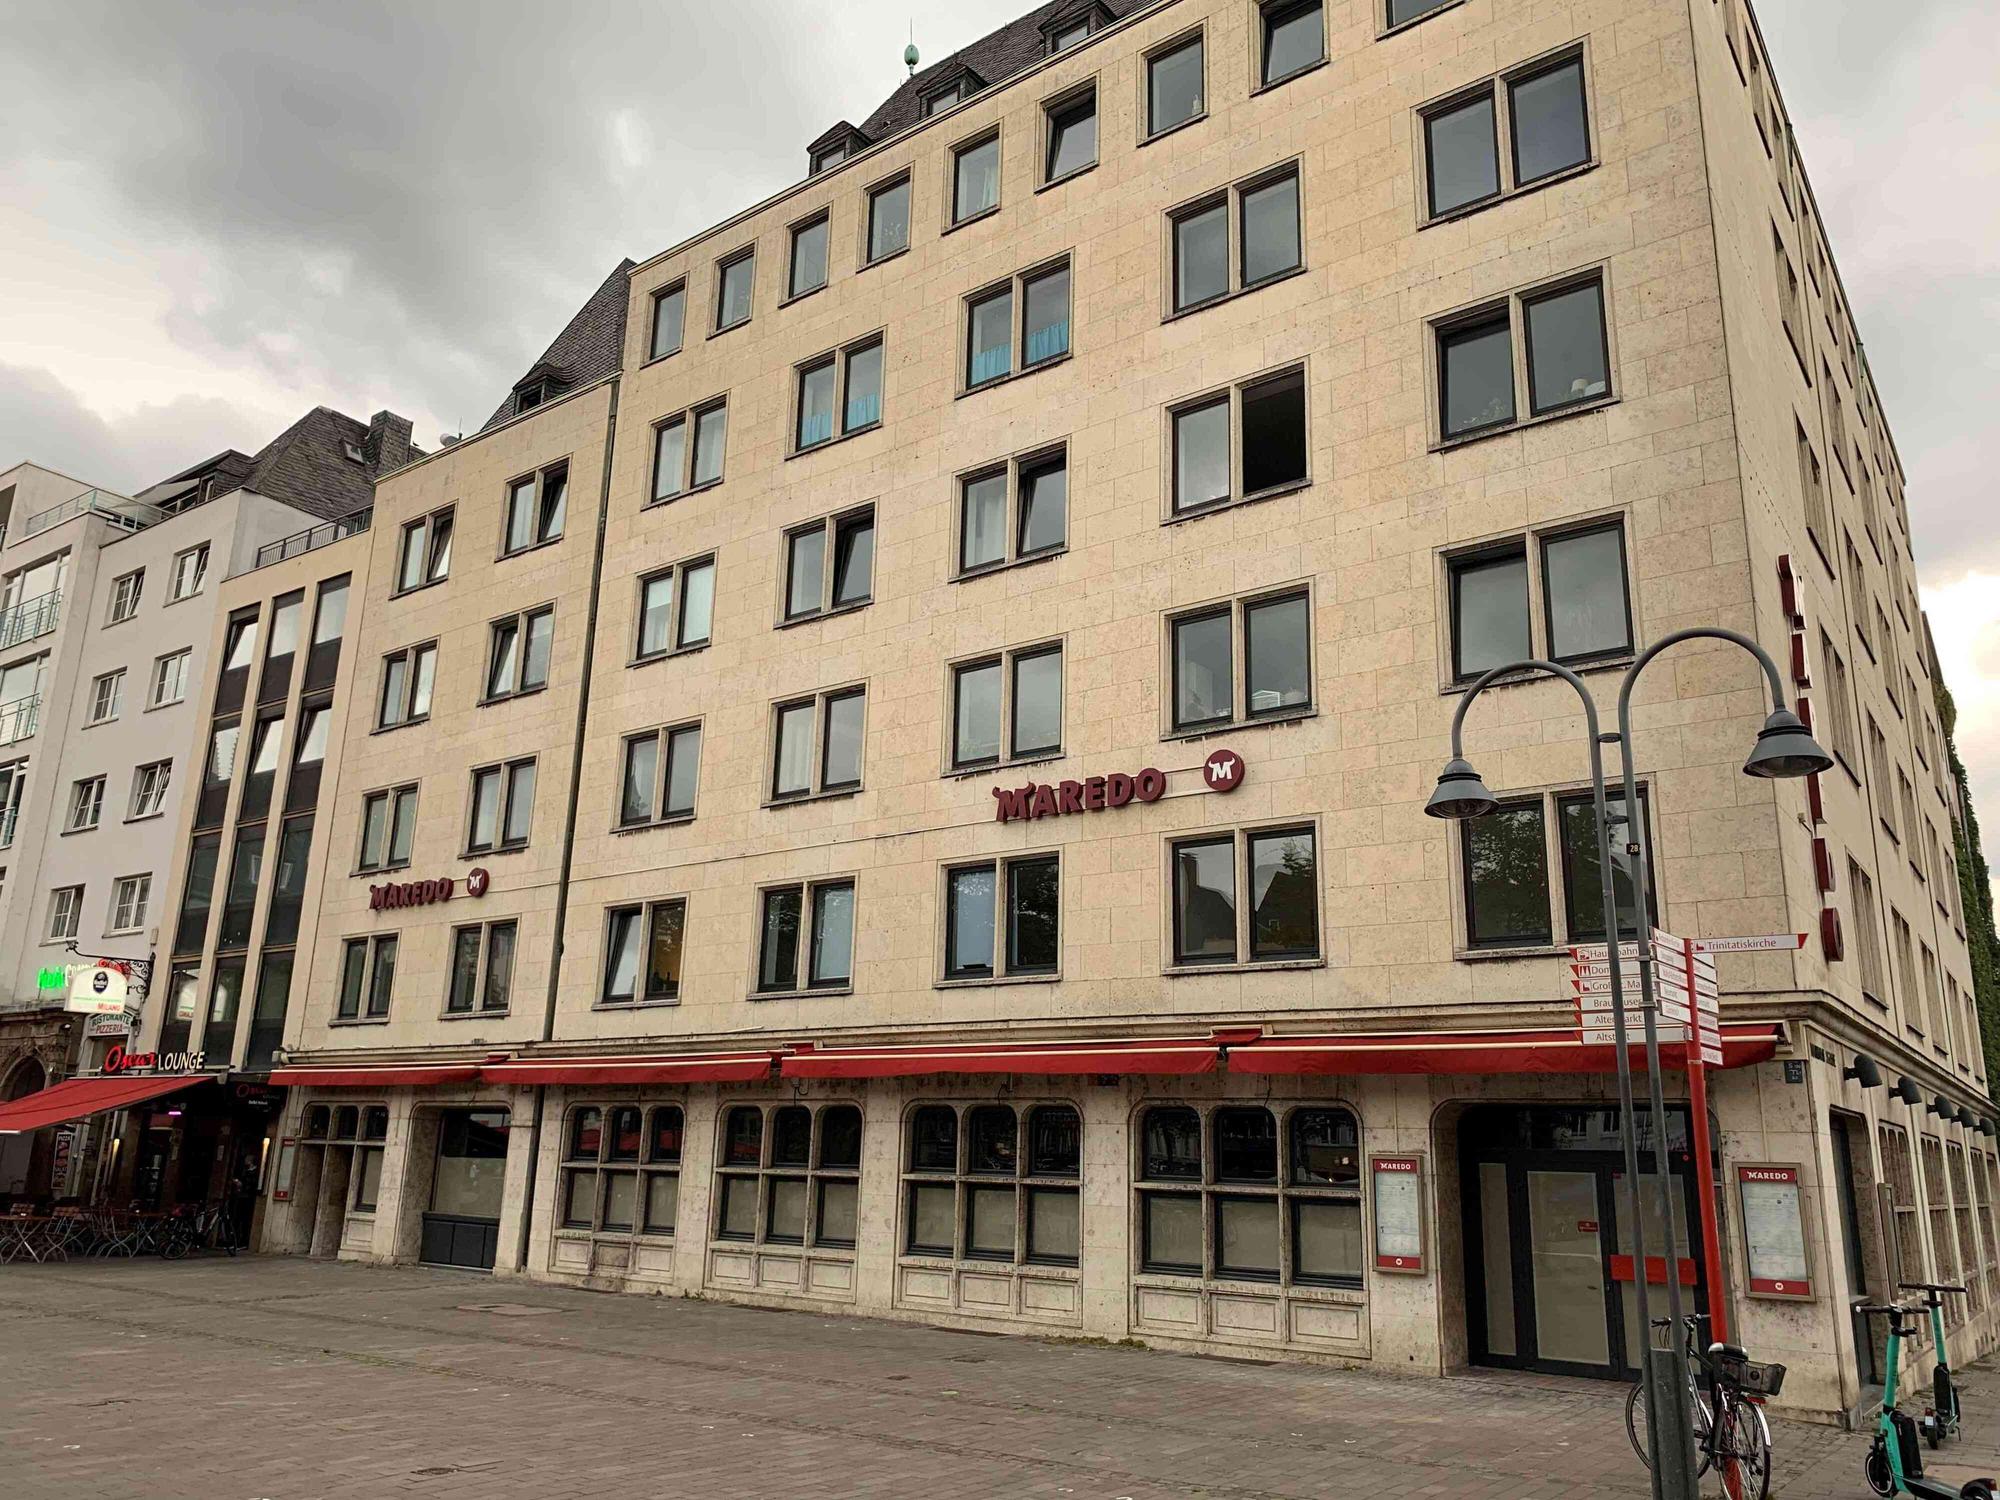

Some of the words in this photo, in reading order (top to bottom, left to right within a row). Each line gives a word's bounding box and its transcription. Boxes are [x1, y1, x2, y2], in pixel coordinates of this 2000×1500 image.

[992, 767, 1167, 825] MAREDO
[369, 877, 455, 912] MAREDO
[1707, 938, 1777, 950] Trinitatiskirche
[92, 1013, 131, 1027] RISTORANTE
[96, 1024, 123, 1034] PIZZERIA
[158, 1051, 205, 1071] LOUNGE
[1380, 1162, 1411, 1170] MAREDO
[1747, 1171, 1788, 1180] MAREDO
